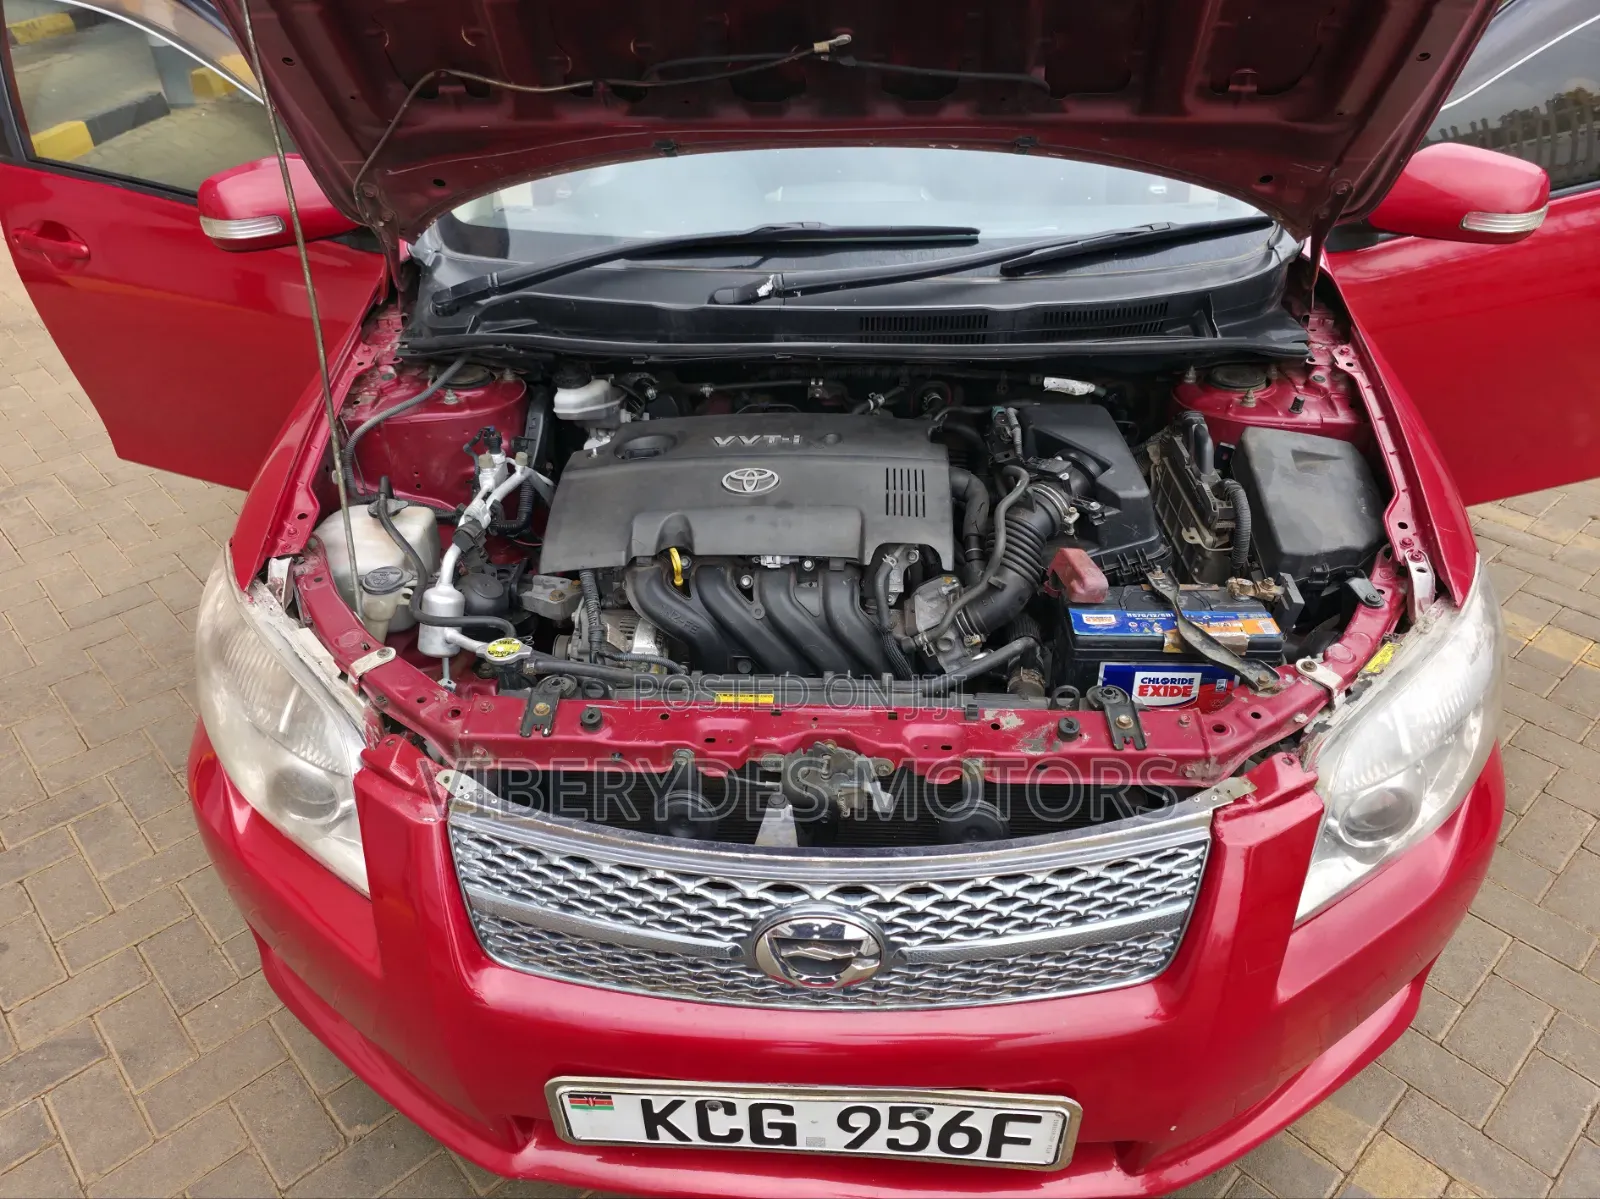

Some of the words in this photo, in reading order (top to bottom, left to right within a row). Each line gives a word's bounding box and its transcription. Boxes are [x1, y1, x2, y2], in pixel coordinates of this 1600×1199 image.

[1140, 677, 1195, 685] CHLORIDE
[1138, 685, 1193, 697] EXIDE
[642, 1098, 798, 1147] KCG
[836, 1105, 1042, 1159] 956F
